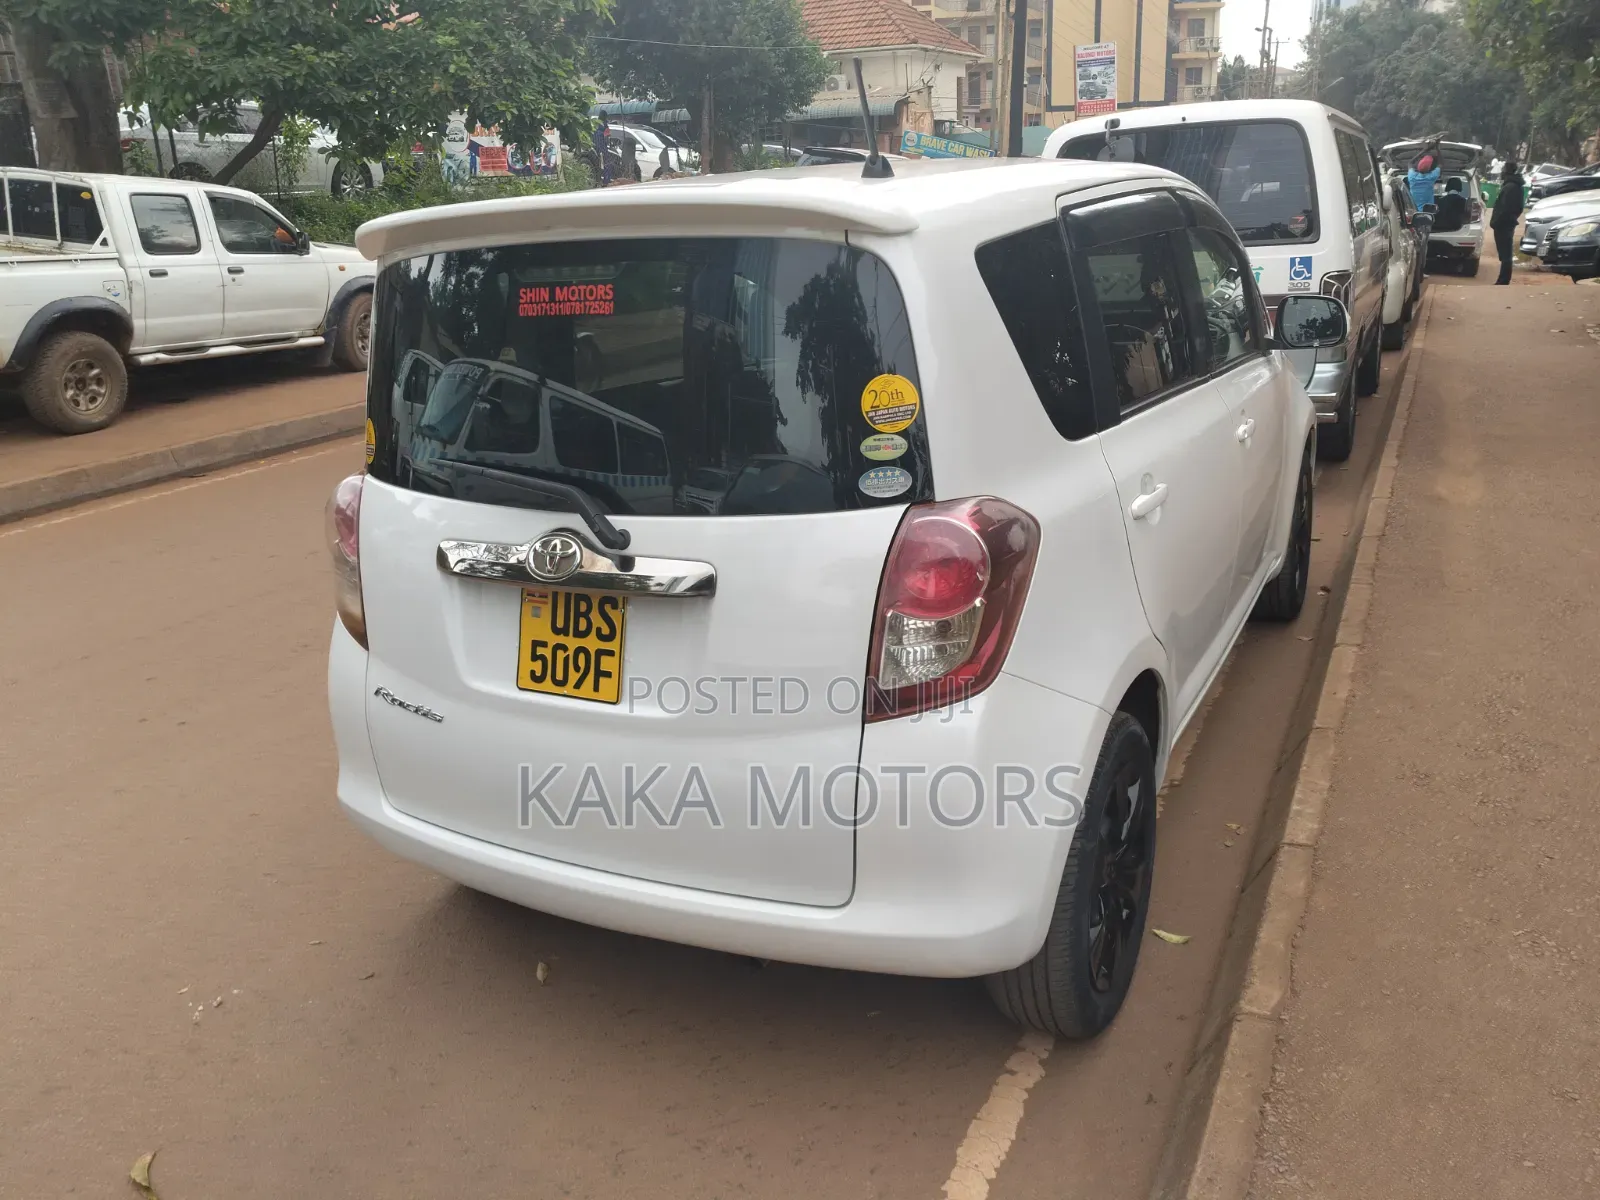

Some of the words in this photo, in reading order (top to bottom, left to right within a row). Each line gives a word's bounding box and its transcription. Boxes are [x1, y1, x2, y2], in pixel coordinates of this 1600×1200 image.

[920, 136, 947, 150] BRAVE
[947, 141, 964, 155] CAR
[966, 146, 990, 159] WASH
[519, 287, 550, 303] SHIN
[555, 284, 614, 301] MOTORS
[868, 388, 905, 409] 20th
[551, 591, 619, 642] UBS
[530, 639, 615, 692] 509F
